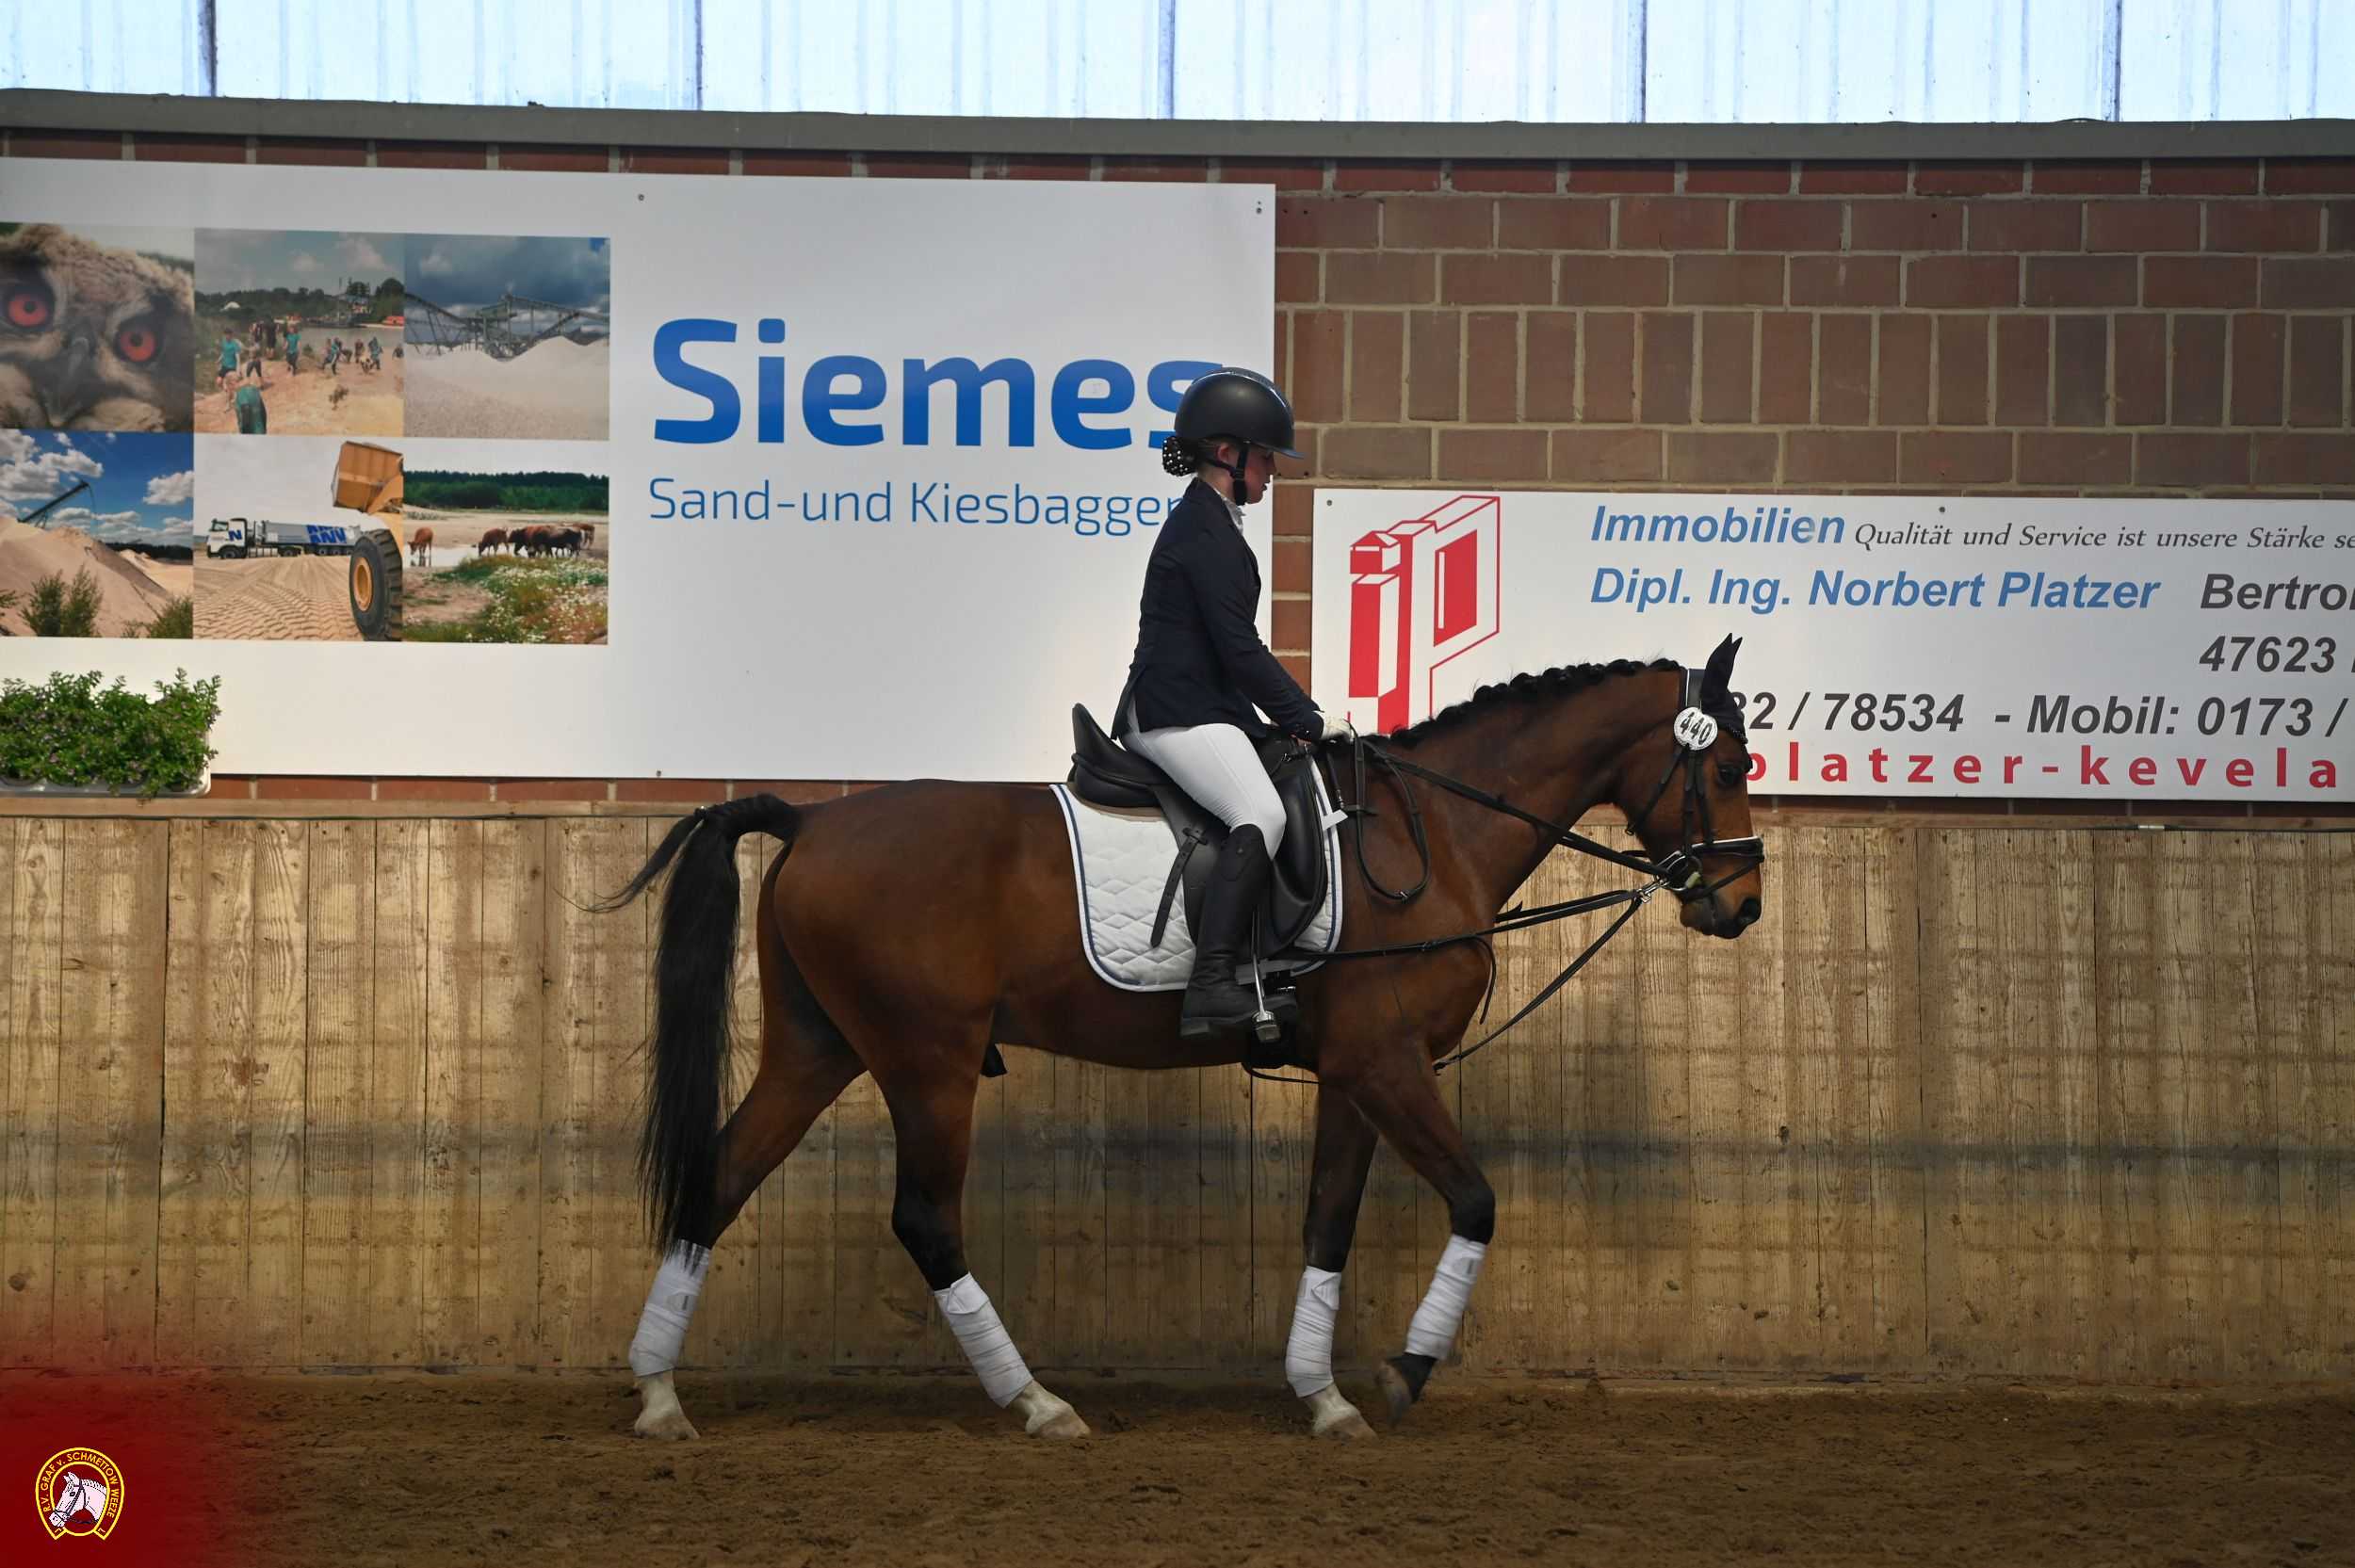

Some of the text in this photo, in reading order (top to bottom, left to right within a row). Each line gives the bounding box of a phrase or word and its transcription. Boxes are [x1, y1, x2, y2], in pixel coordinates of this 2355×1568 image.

[652, 316, 1223, 451] Siemes
[649, 476, 892, 523] Sand-und
[1590, 505, 1846, 543] Immobilien
[1854, 522, 1953, 552] Qualität
[1962, 523, 2013, 546] und
[2019, 525, 2107, 548] Service
[2117, 526, 2148, 548] ist
[2156, 532, 2239, 549] unsere
[2247, 525, 2326, 549] Stärke
[1590, 566, 2163, 615] Dipl. Ing. Norbert Platzer
[2200, 573, 2355, 611] Bertro
[2199, 635, 2337, 673] 47623
[1680, 711, 1713, 746] 440
[1824, 692, 1965, 733] 78534
[2026, 694, 2179, 735] Mobil:
[2197, 696, 2314, 736] 0173
